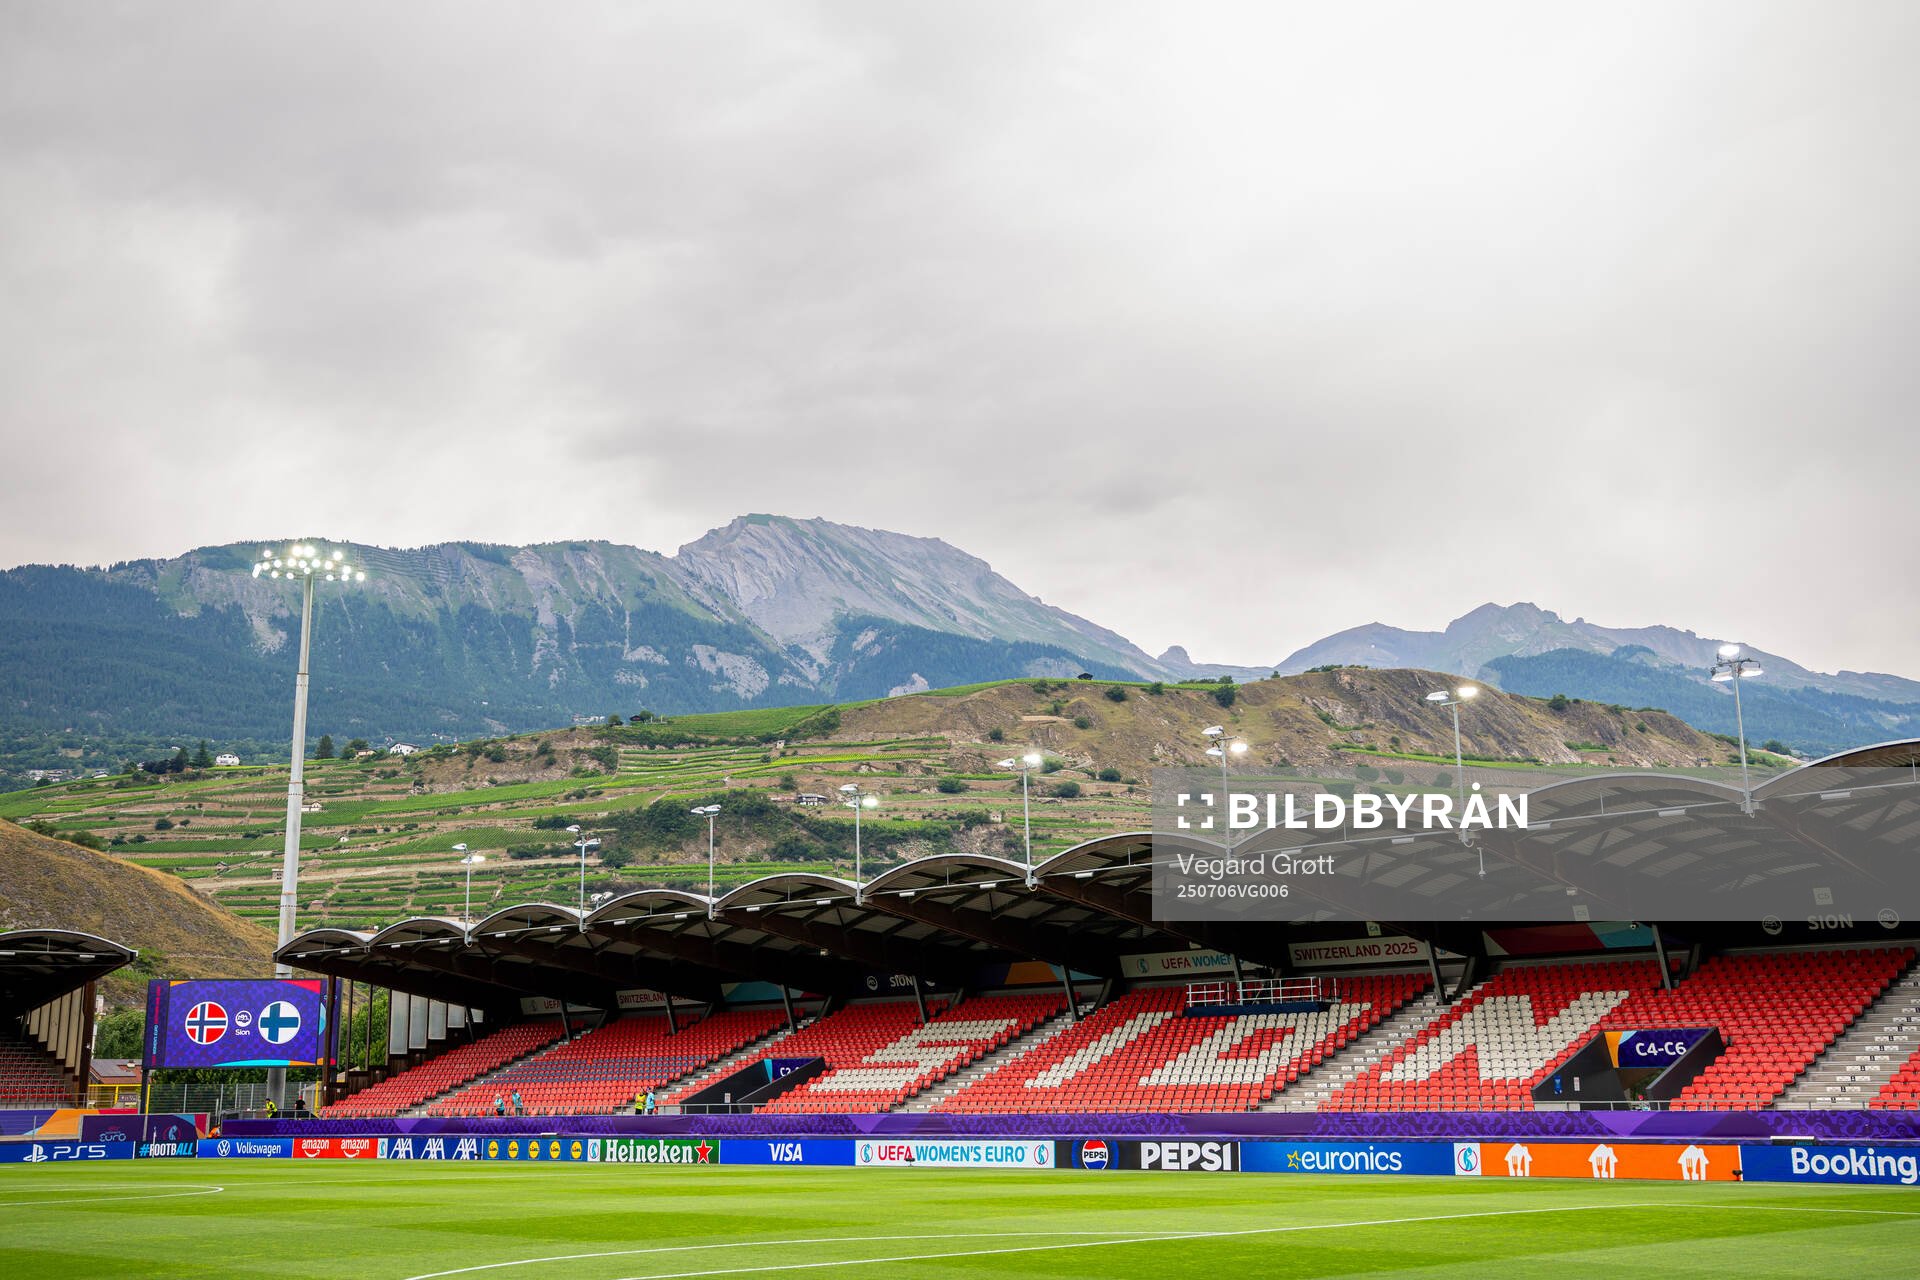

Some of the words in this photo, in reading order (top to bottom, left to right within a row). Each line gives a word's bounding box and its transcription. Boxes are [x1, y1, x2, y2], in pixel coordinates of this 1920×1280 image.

[1807, 913, 1854, 930] SION
[1294, 944, 1381, 960] SWITZERLAND
[1384, 942, 1418, 956] 2025
[1161, 957, 1192, 970] UEFA
[889, 974, 914, 988] SION
[235, 1028, 250, 1036] Sion
[1635, 1041, 1687, 1056] C4-C6
[53, 1145, 106, 1159] PS5
[139, 1142, 193, 1157] #FOOTBALL
[236, 1141, 281, 1157] Volkswagen
[301, 1139, 330, 1150] amazon
[340, 1139, 370, 1150] amazon
[390, 1138, 414, 1159] AXA
[420, 1138, 445, 1159] AXA
[452, 1138, 478, 1160] AXA
[605, 1139, 694, 1163] Heineken
[768, 1143, 803, 1162] VISA
[877, 1145, 913, 1161] UEFA
[915, 1145, 982, 1162] WOMEN'S
[985, 1145, 1026, 1163] EURO
[1083, 1150, 1107, 1159] PEPSI
[1140, 1142, 1232, 1171] PEPSI
[1301, 1145, 1403, 1171] euronics
